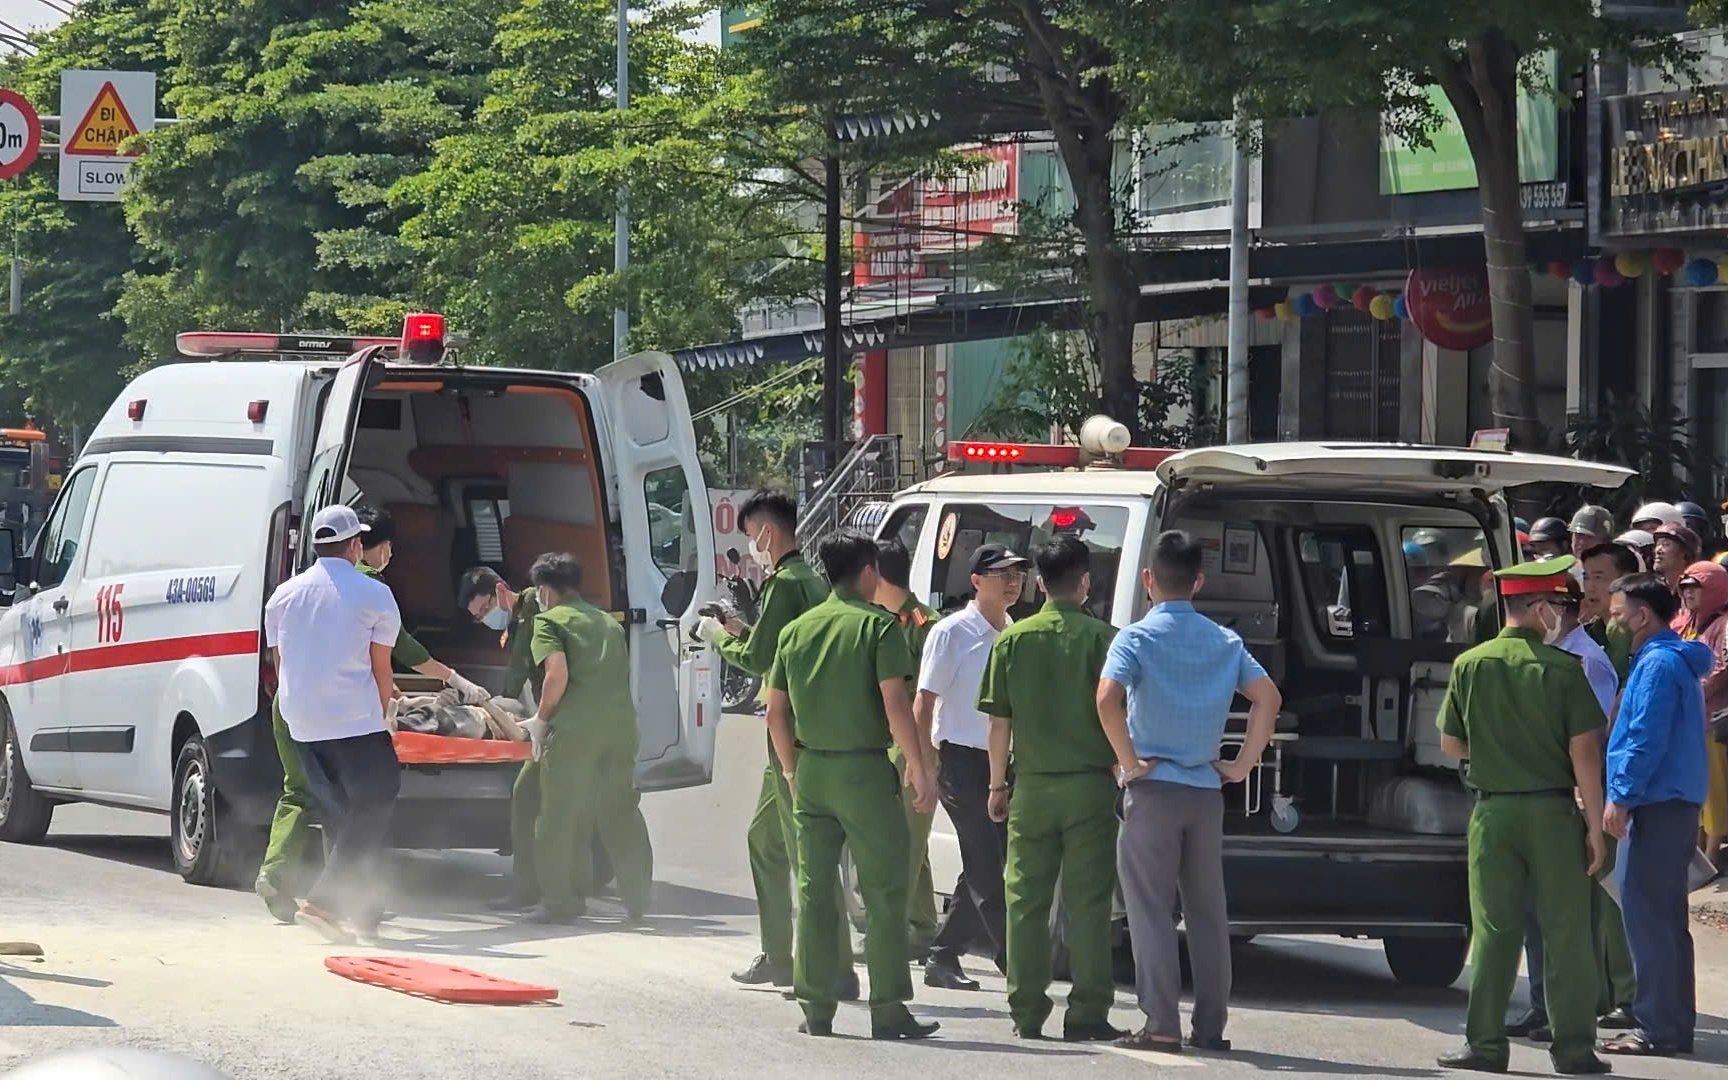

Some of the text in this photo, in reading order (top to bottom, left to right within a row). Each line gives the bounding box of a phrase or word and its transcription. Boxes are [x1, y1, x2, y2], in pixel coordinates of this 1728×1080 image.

[100, 107, 116, 121] ĐI
[165, 575, 216, 605] 43A-00569
[96, 583, 124, 643] 115
